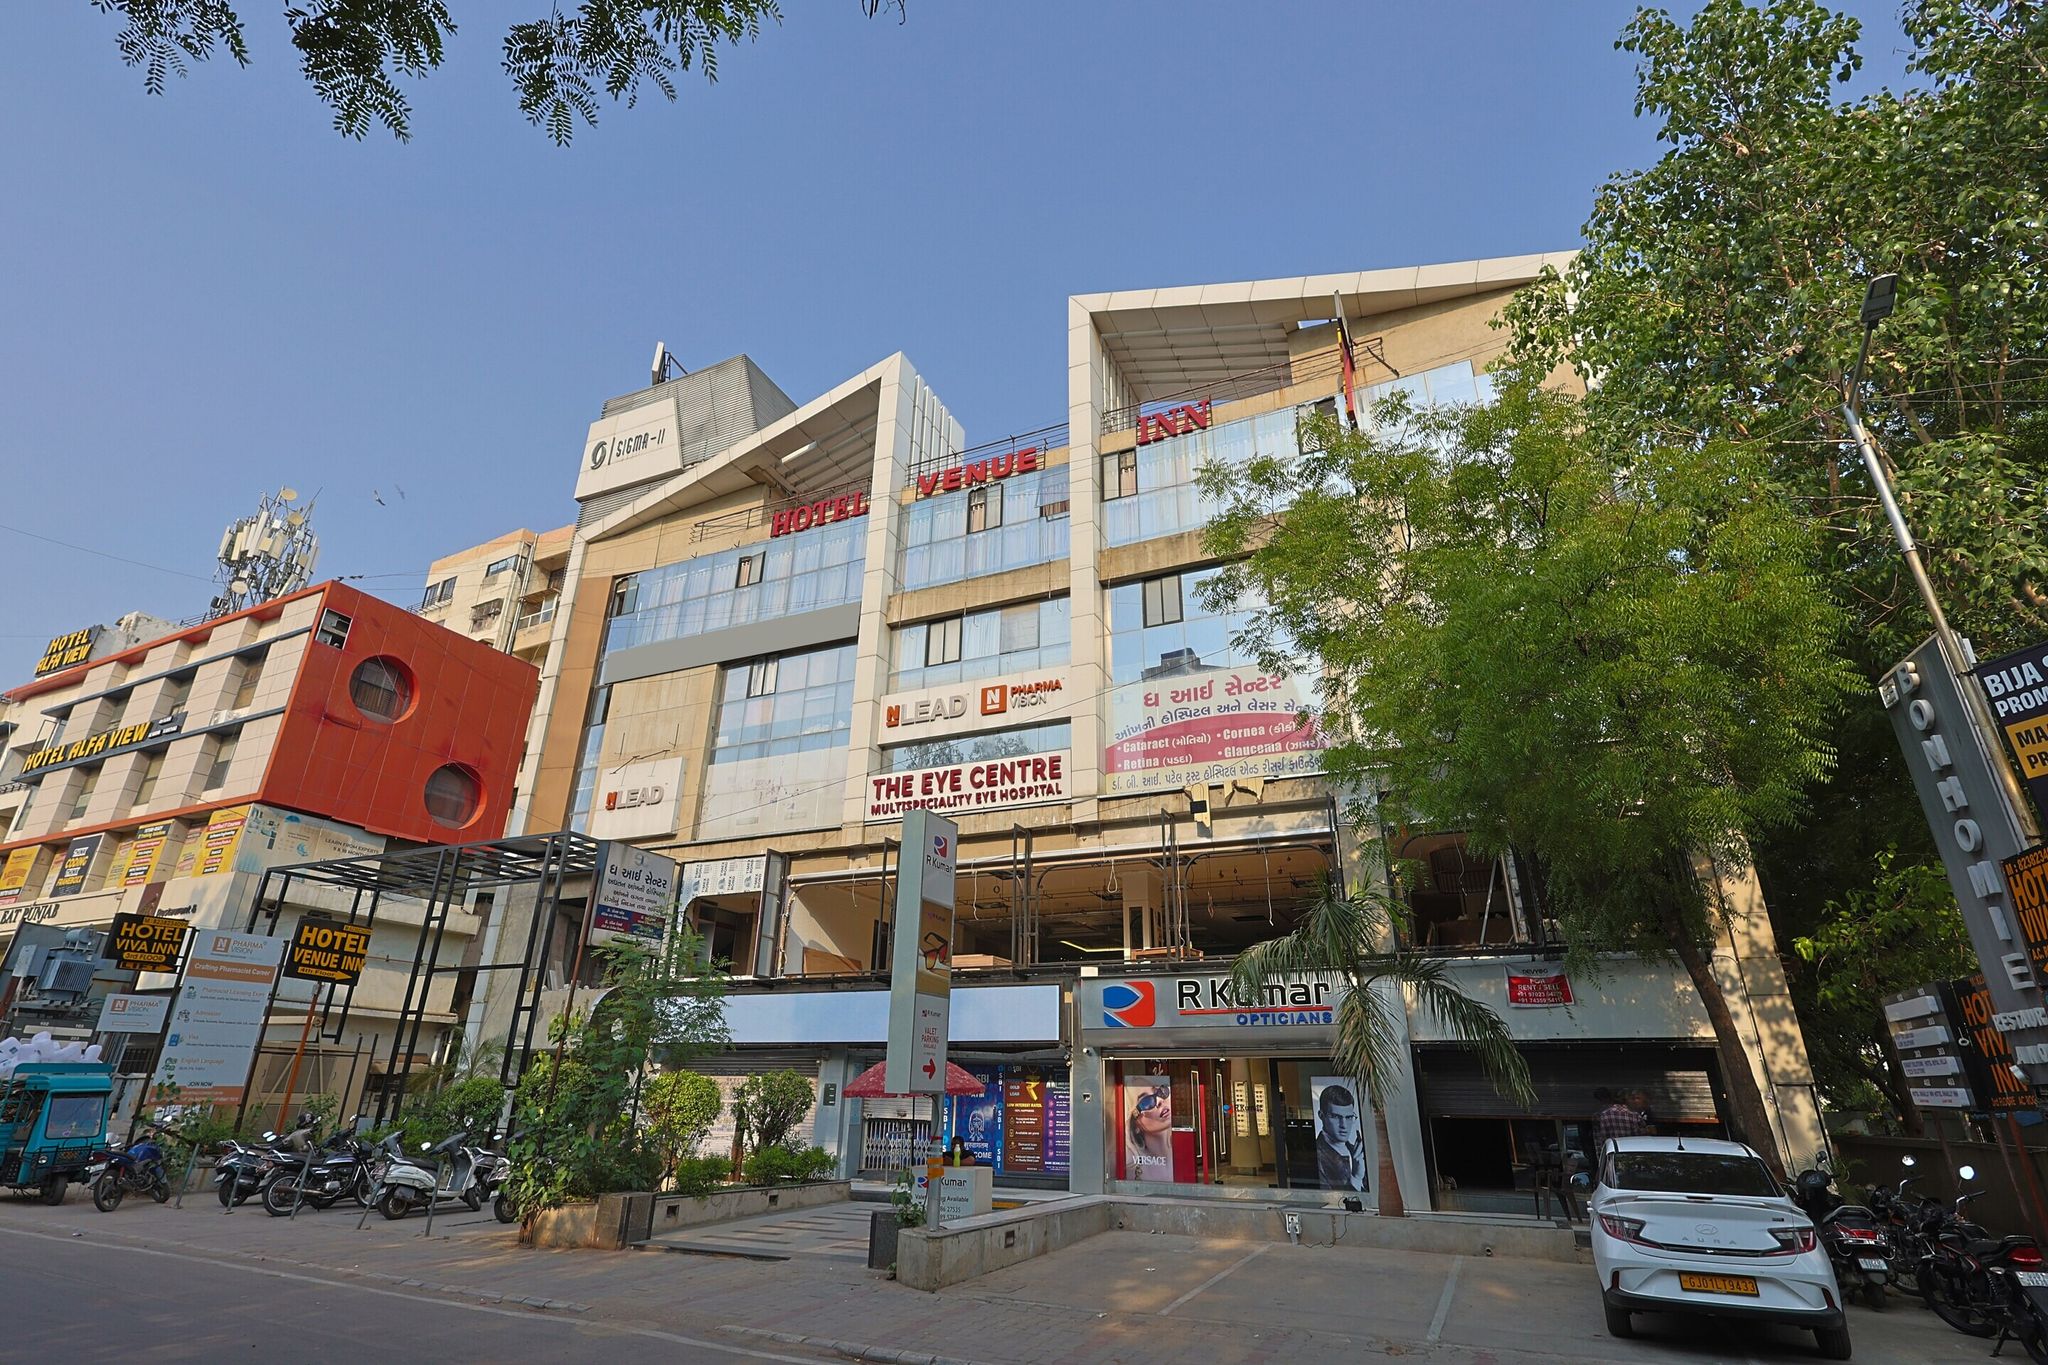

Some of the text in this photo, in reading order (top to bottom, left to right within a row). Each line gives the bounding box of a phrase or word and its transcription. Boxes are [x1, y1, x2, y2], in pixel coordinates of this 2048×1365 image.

[1137, 400, 1211, 445] INN
[616, 428, 666, 457] SIGMA-II
[918, 446, 1038, 495] VENUE
[770, 490, 869, 538] HOTEL
[47, 629, 90, 654] HOTEL
[35, 643, 93, 673] ALFA VIEW
[1011, 679, 1062, 697] PHARMA
[1984, 661, 2043, 697] BIJA
[1011, 694, 1047, 709] VISION
[1223, 726, 1265, 741] Cornea
[21, 745, 68, 774] HOTEL
[68, 733, 109, 761] ALFA
[108, 721, 152, 749] VIEW
[1123, 737, 1169, 753] Cataract
[1124, 756, 1160, 771] Retina
[872, 755, 1062, 801] THE EYE CENTRE
[871, 782, 1063, 816] MULTISPECIALITY EYE HOSPITAL
[926, 855, 953, 874] R Kumar
[24, 904, 60, 923] PUNJAB
[120, 921, 182, 942] HOTEL
[299, 925, 369, 955] HOTEL
[116, 938, 179, 956] VIVA INN
[232, 939, 264, 949] PHARMA
[140, 953, 165, 962] FLOOR
[293, 946, 367, 972] VENUE INN
[194, 962, 219, 972] Crafting
[219, 965, 252, 975] Pharmacist
[129, 1000, 160, 1008] PHARMA
[1176, 978, 1202, 1011] R
[1236, 1011, 1333, 1027] OPTICIANS
[1132, 1155, 1168, 1167] VERSACE
[1681, 1236, 1737, 1246] AURA
[1688, 1277, 1756, 1293] GJ01LT9433
